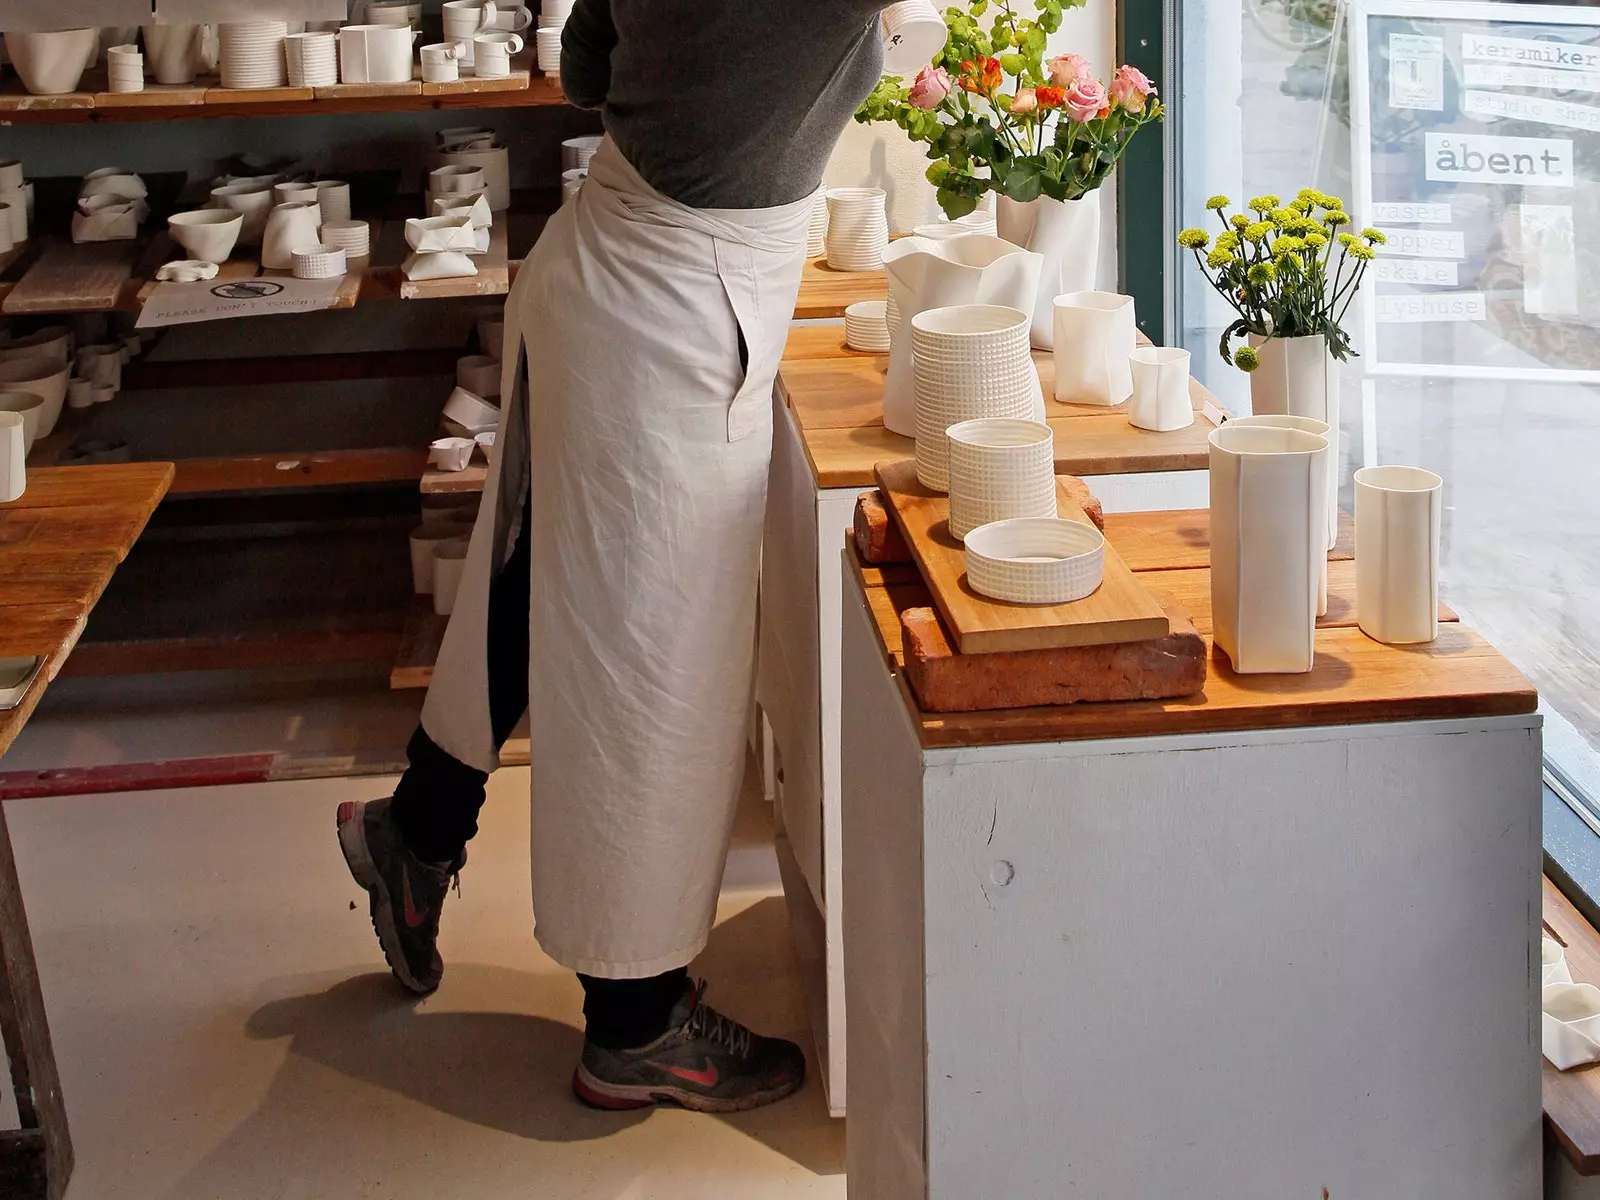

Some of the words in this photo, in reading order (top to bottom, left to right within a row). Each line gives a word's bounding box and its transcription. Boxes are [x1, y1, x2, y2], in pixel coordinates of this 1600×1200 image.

[1471, 39, 1598, 67] keramiker
[1475, 95, 1542, 116] studio
[1436, 140, 1562, 177] åbent
[1373, 207, 1445, 220] vaser
[1387, 233, 1458, 253] opper
[156, 308, 207, 318] PLEASE
[216, 303, 257, 311] DON'T
[267, 299, 317, 307] TOUCH!
[1379, 296, 1479, 318] lyshuse
